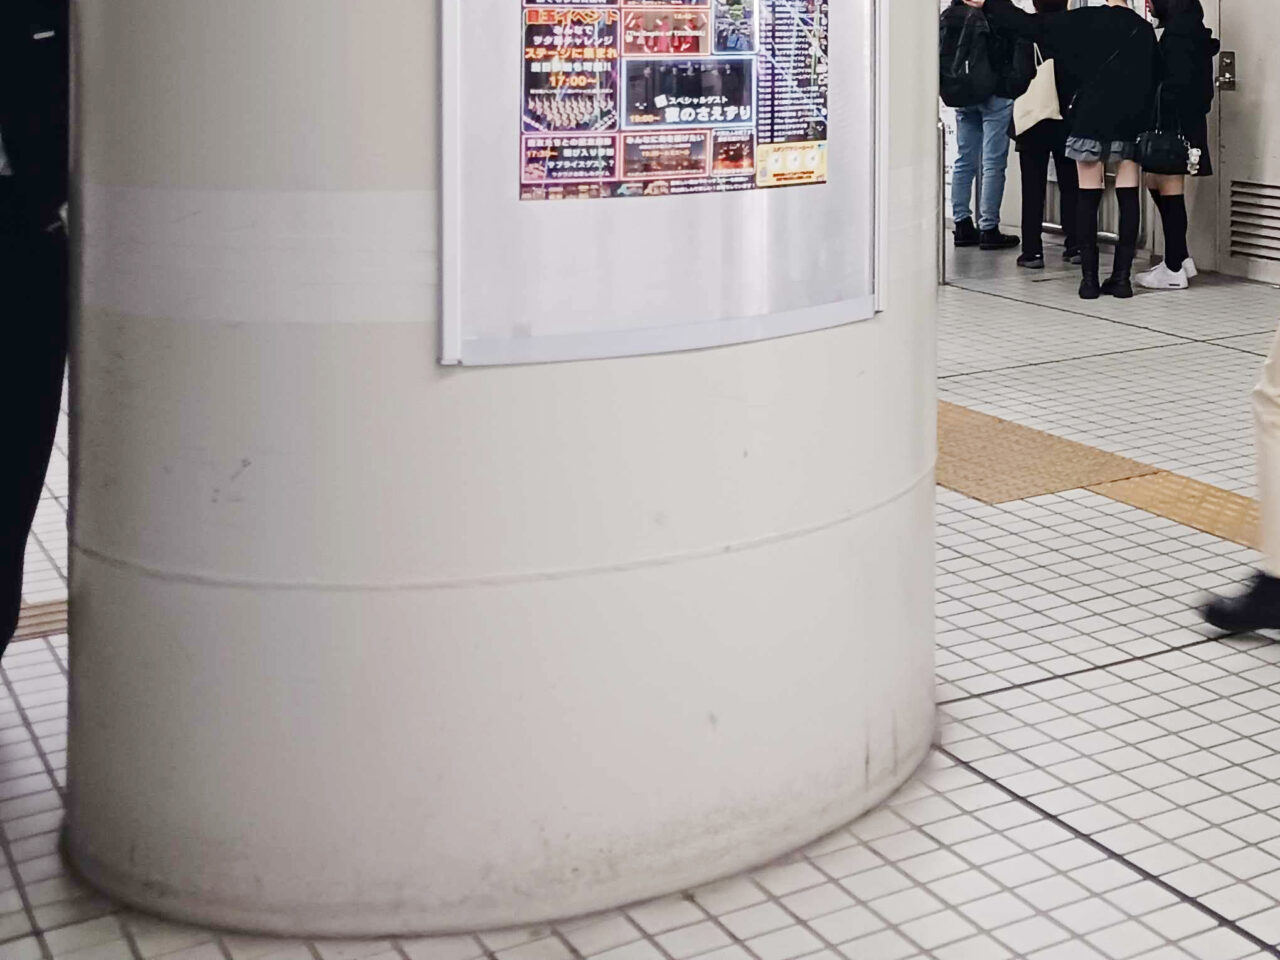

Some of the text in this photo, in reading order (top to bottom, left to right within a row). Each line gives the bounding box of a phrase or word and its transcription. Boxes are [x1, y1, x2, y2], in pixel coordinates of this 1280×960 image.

[526, 9, 618, 25] 目玉イベント
